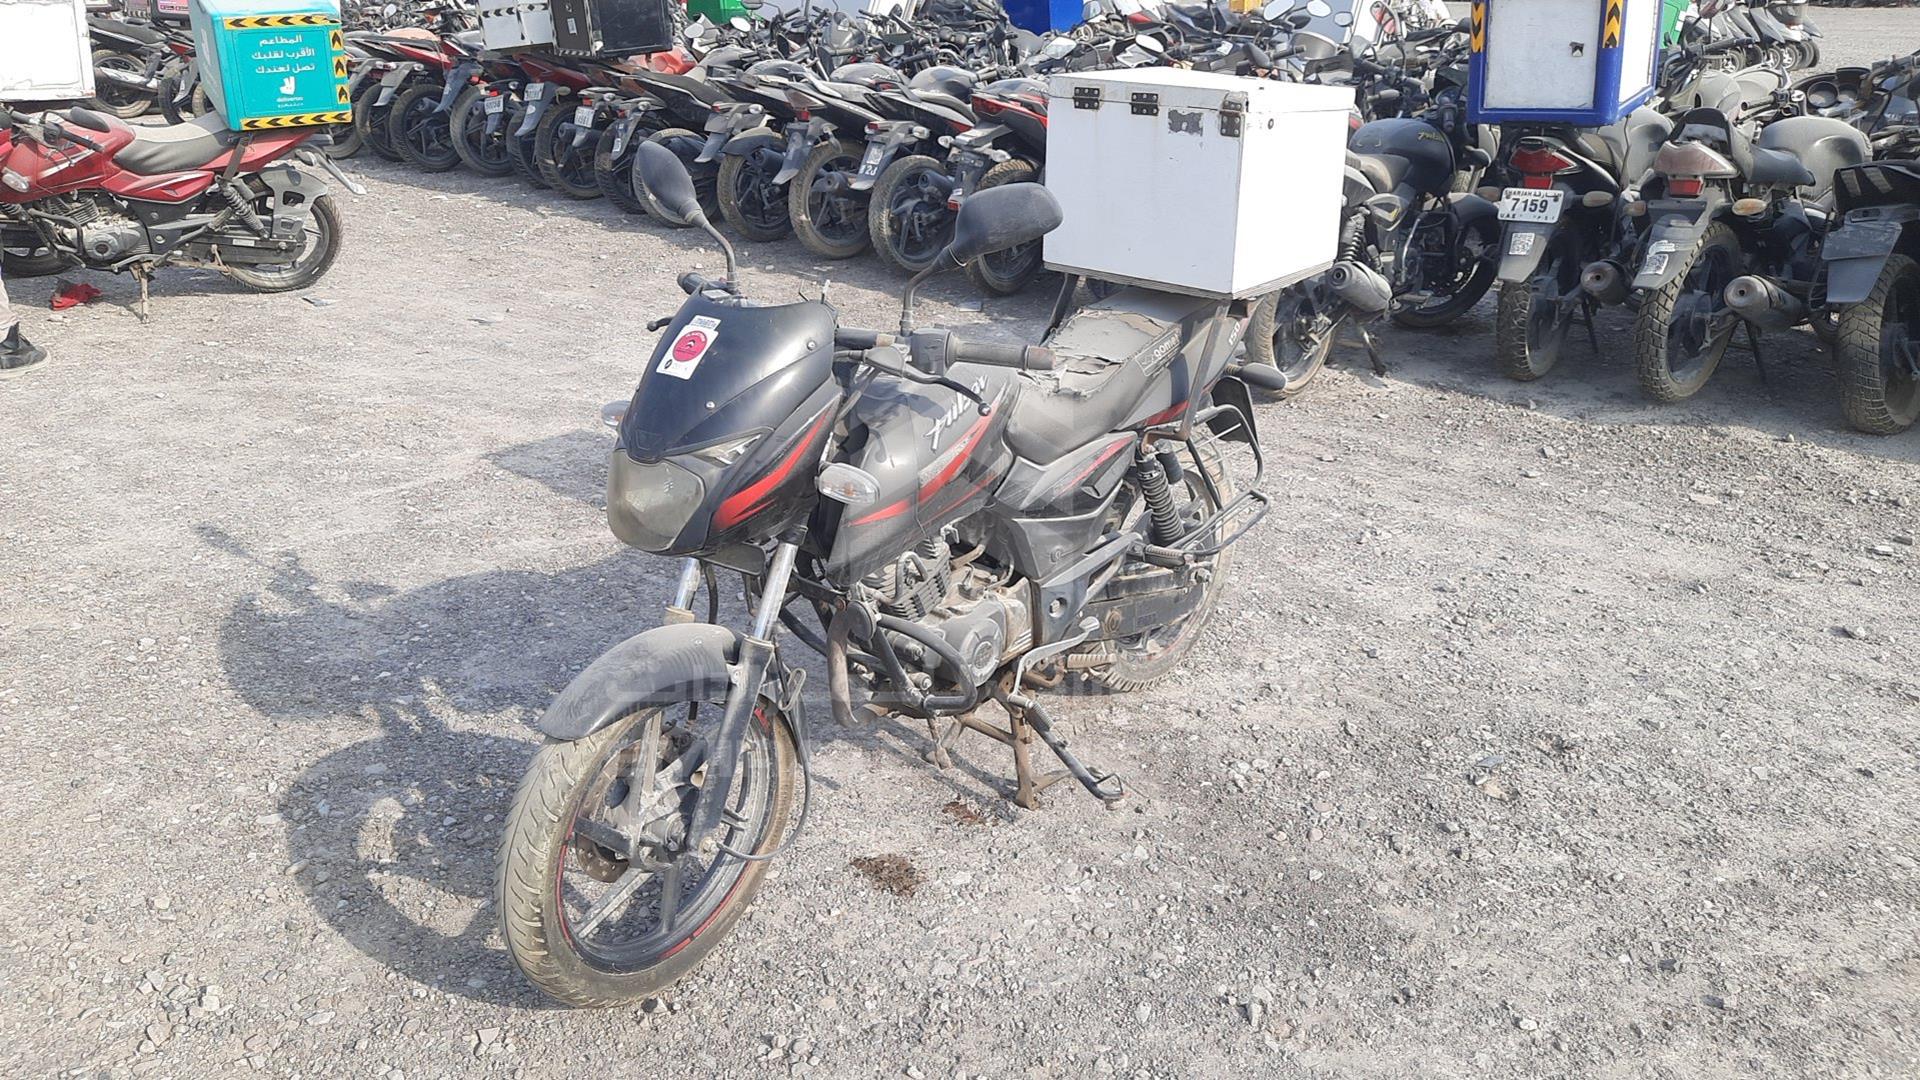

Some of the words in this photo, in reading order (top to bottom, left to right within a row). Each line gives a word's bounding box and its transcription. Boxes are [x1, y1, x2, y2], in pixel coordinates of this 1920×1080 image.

[259, 34, 303, 47] المطاعم
[292, 63, 315, 73] تصل
[1511, 197, 1549, 213] 7159
